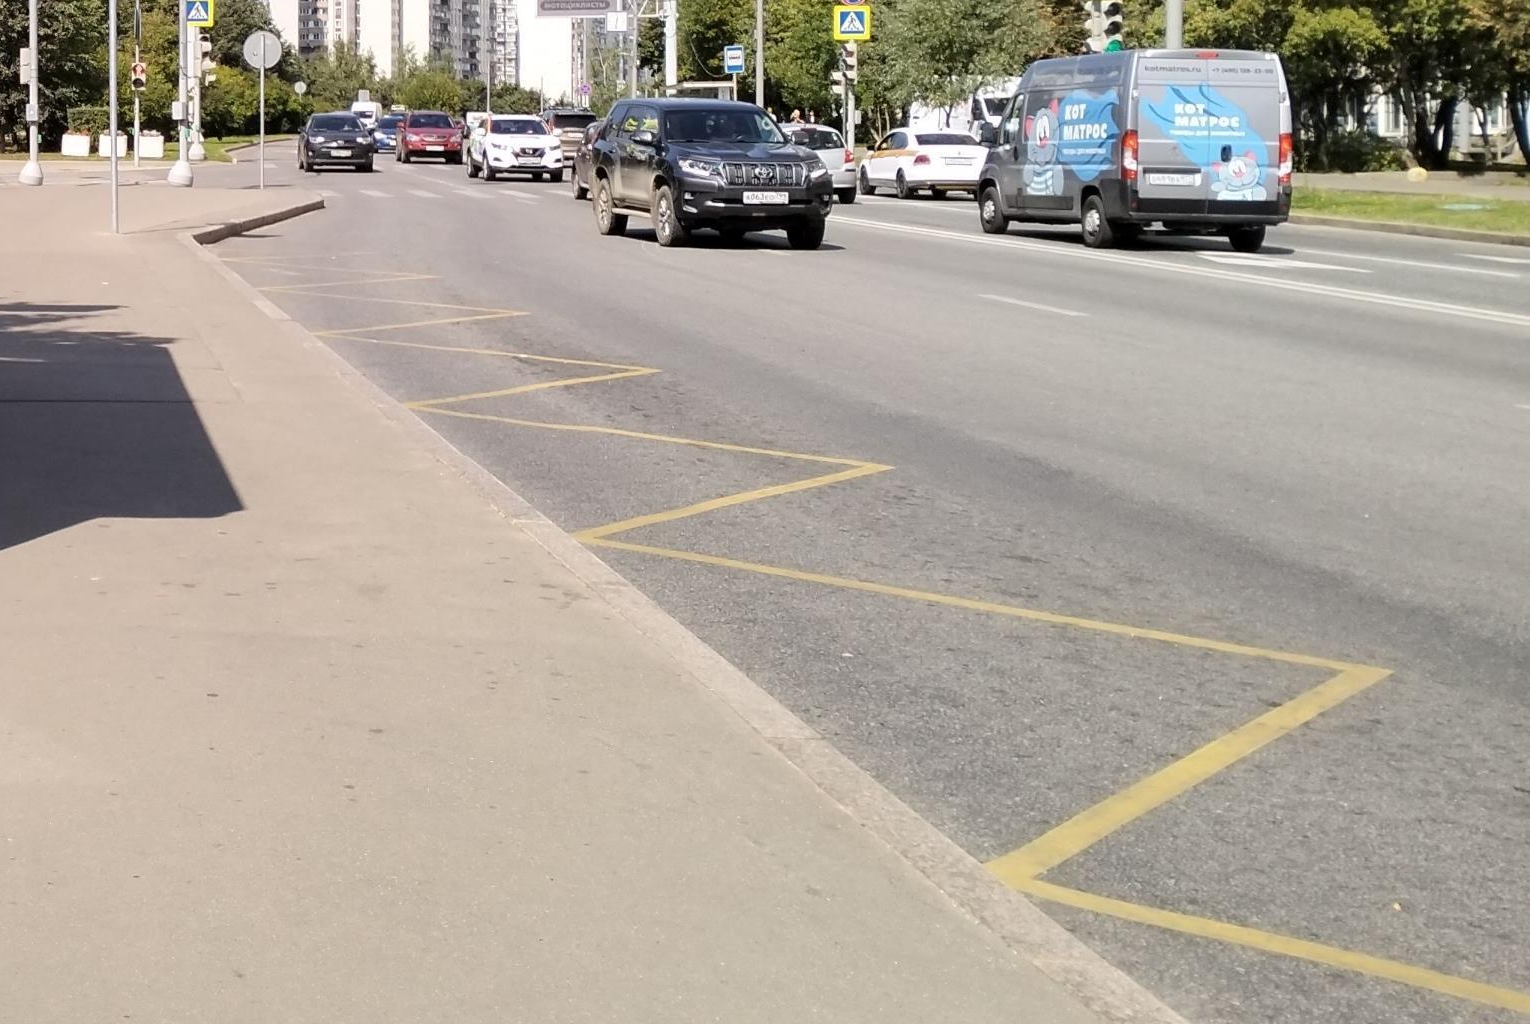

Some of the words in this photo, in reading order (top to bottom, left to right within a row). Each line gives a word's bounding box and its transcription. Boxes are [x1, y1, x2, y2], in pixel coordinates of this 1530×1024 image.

[1065, 103, 1087, 121] КОТ
[1174, 103, 1206, 114] КОТ
[1174, 116, 1240, 128] МАТРОС
[1063, 123, 1108, 141] МАТРОС
